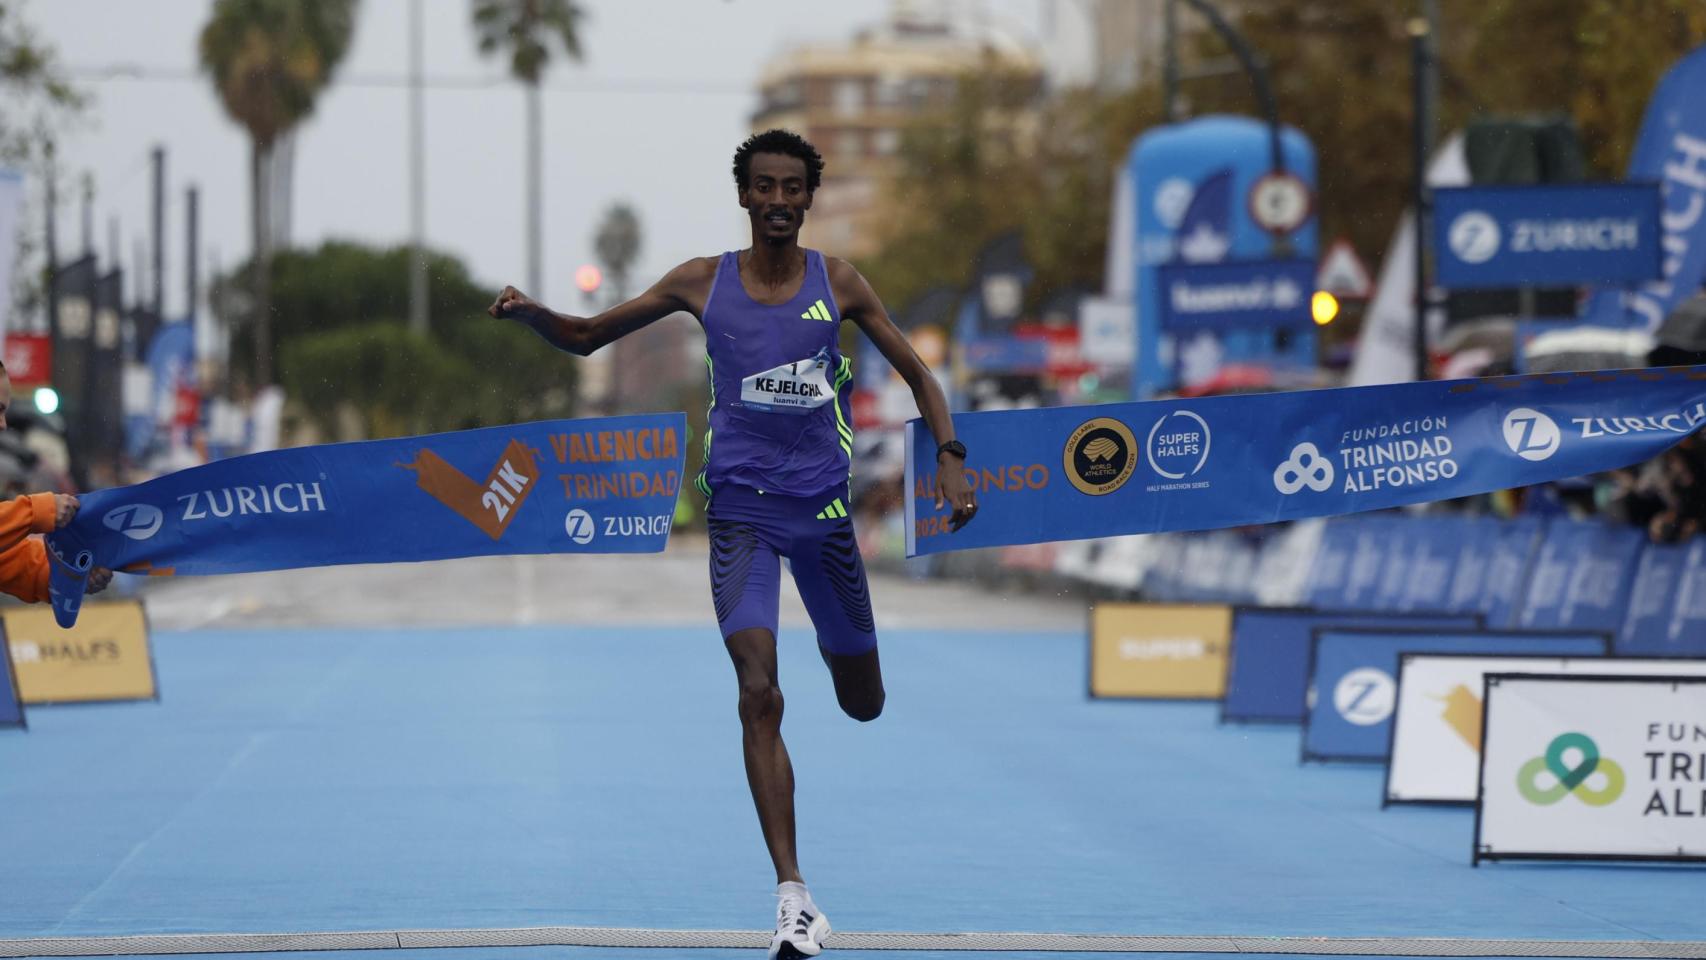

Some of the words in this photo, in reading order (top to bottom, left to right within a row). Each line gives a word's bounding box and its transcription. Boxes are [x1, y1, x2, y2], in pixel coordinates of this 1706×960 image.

[1510, 219, 1638, 252] ZURICH
[791, 363, 798, 376] 1
[755, 378, 823, 397] KEJELCHA
[773, 397, 798, 405] luanvi
[1341, 416, 1448, 443] FUNDACIÓN
[1572, 403, 1706, 439] ZURICH
[548, 428, 678, 464] VALENCIA
[1067, 435, 1079, 453] GOLD
[1077, 423, 1096, 438] LABEL
[1158, 445, 1199, 457] HALFS
[1159, 432, 1199, 445] SUPER
[1340, 435, 1452, 469] TRINIDAD
[1084, 469, 1117, 477] ATHLETICS
[1089, 463, 1112, 471] WORLD
[1343, 459, 1458, 493] ALFONSO
[482, 459, 529, 523] 21K
[559, 471, 678, 499] TRINIDAD
[915, 464, 1050, 498] ALONSO
[1098, 482, 1115, 492] ROAD
[1115, 470, 1130, 485] RACE
[1161, 483, 1191, 491] MARATHON
[177, 482, 326, 521] ZURICH
[603, 515, 670, 536] ZURICH
[1647, 723, 1706, 741] FUN
[1644, 751, 1706, 781] TRI
